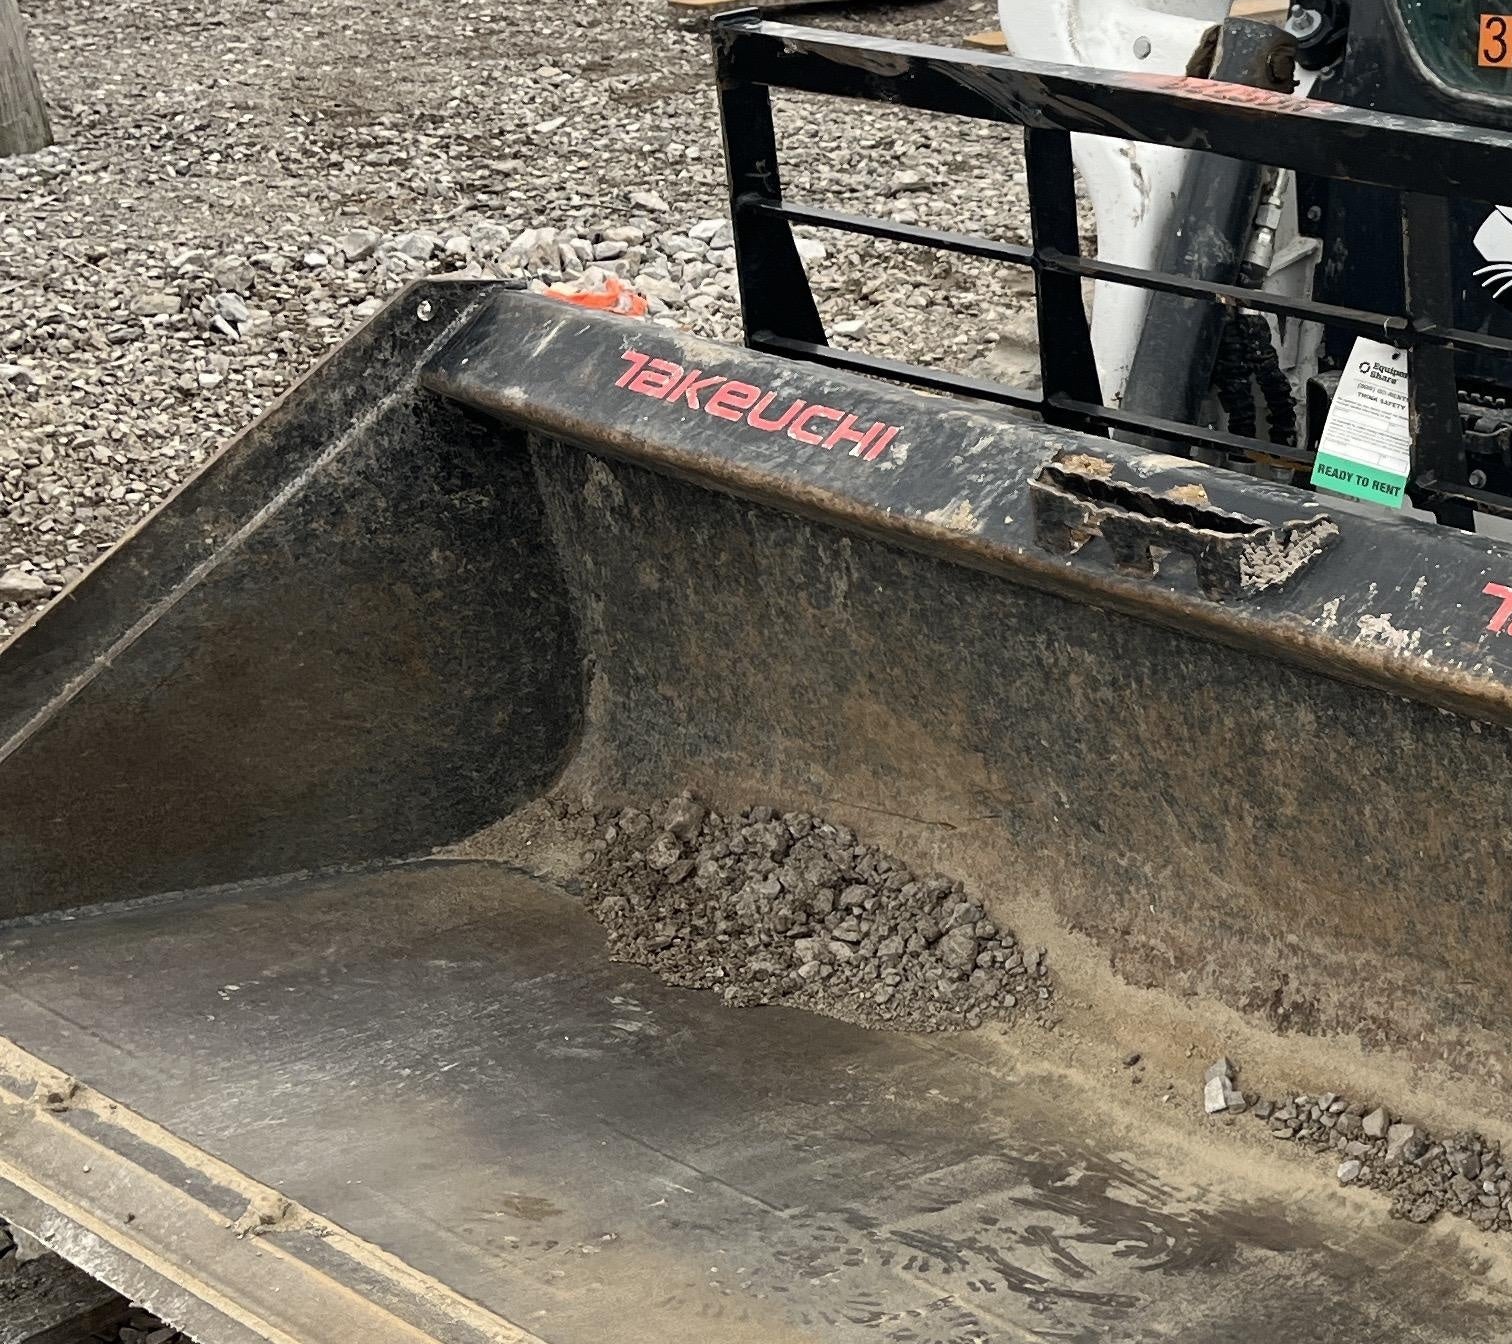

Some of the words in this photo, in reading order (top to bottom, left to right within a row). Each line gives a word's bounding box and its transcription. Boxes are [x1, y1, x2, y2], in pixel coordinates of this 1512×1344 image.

[1317, 462, 1353, 483] READY
[1355, 474, 1370, 488] TO
[1372, 480, 1401, 497] RENT
